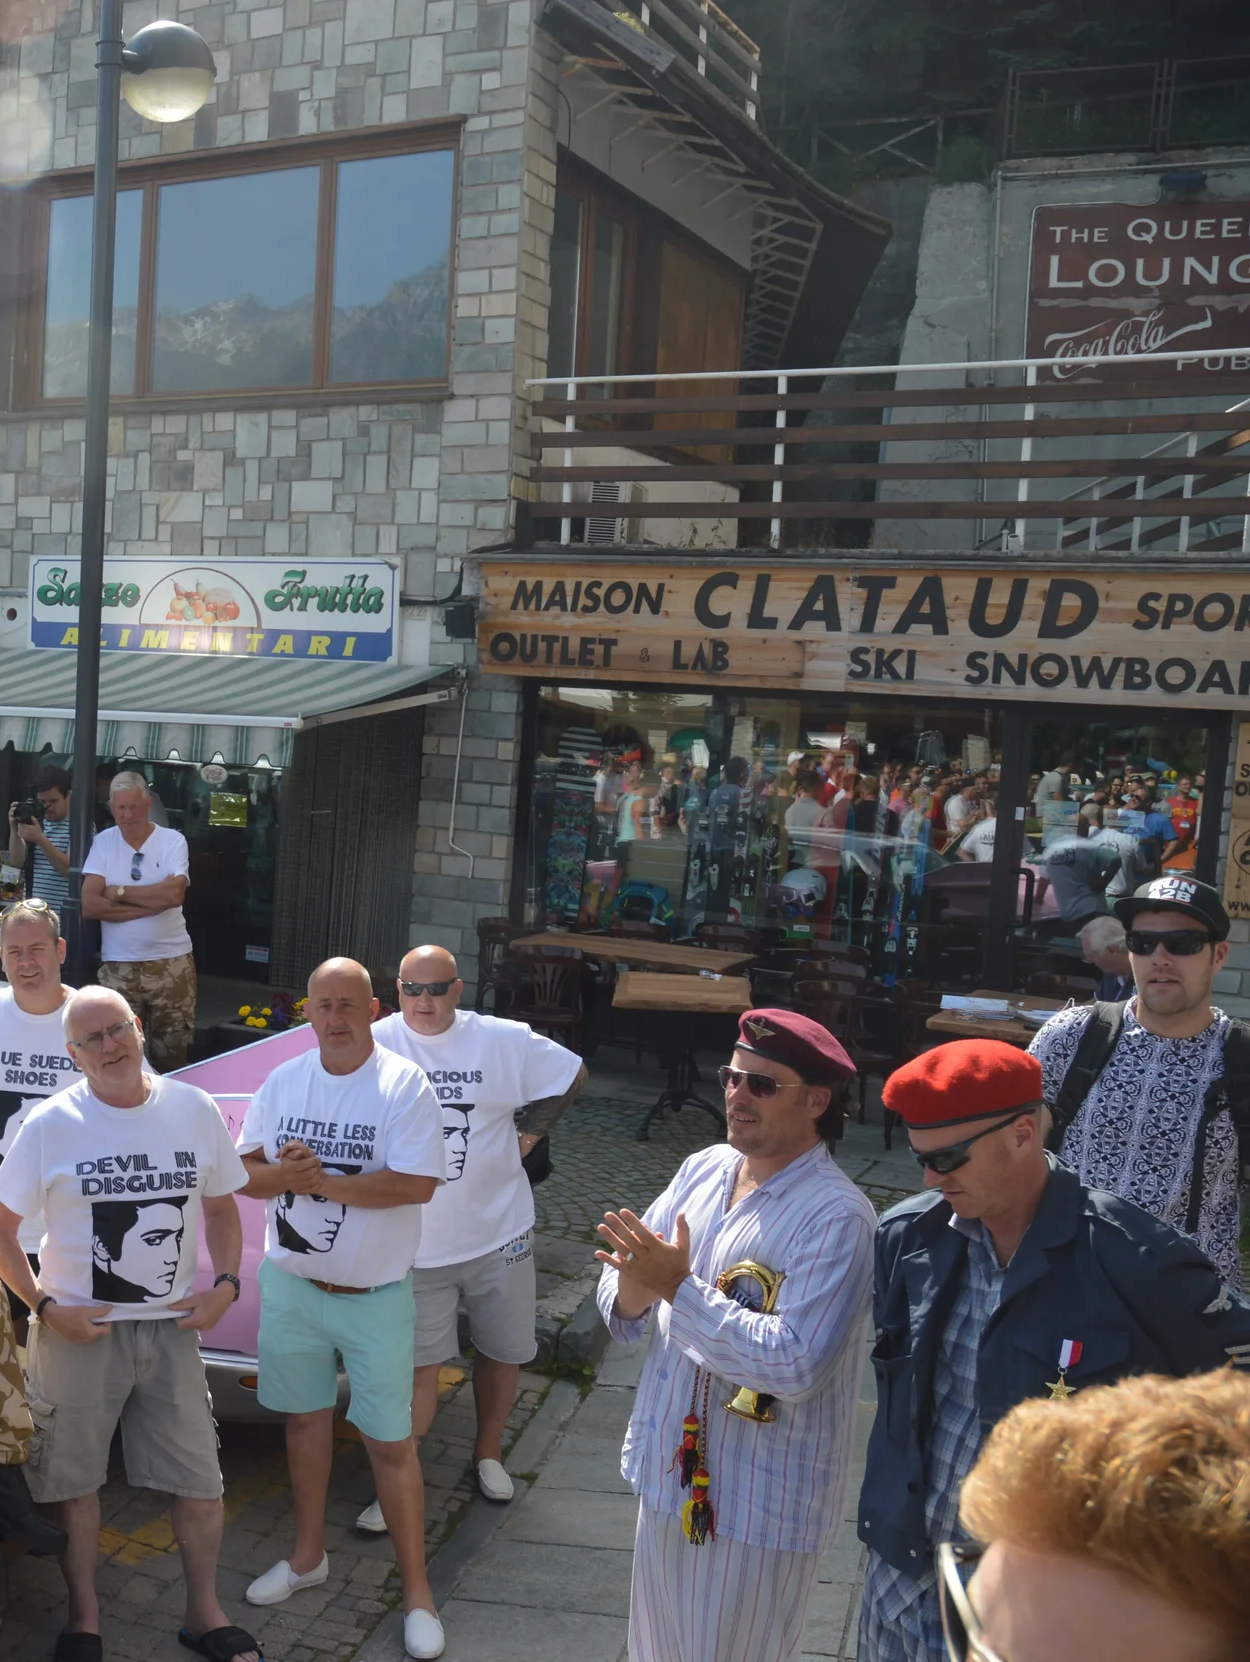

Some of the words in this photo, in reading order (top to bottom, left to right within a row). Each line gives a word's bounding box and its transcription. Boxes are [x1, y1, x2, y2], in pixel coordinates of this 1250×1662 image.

[1049, 226, 1109, 243] THE
[1127, 217, 1250, 244] QUEE
[36, 566, 141, 608] Saze
[263, 569, 385, 614] Frutta
[509, 579, 666, 616] MAISON
[693, 571, 1100, 640] CLATAUD
[489, 632, 618, 668] OUTLET
[639, 647, 650, 663] &
[672, 638, 730, 672] LAB
[847, 646, 917, 681] SKI
[4, 1069, 58, 1087] SHOES
[277, 1115, 284, 1132] A
[286, 1117, 338, 1139] LITTLE
[343, 1123, 377, 1142] LESS
[276, 1134, 374, 1160] COERSATION
[76, 1153, 158, 1176] DEVIL
[175, 1151, 197, 1169] IN
[81, 1170, 197, 1196] DISGUISE
[505, 1257, 514, 1266] ST
